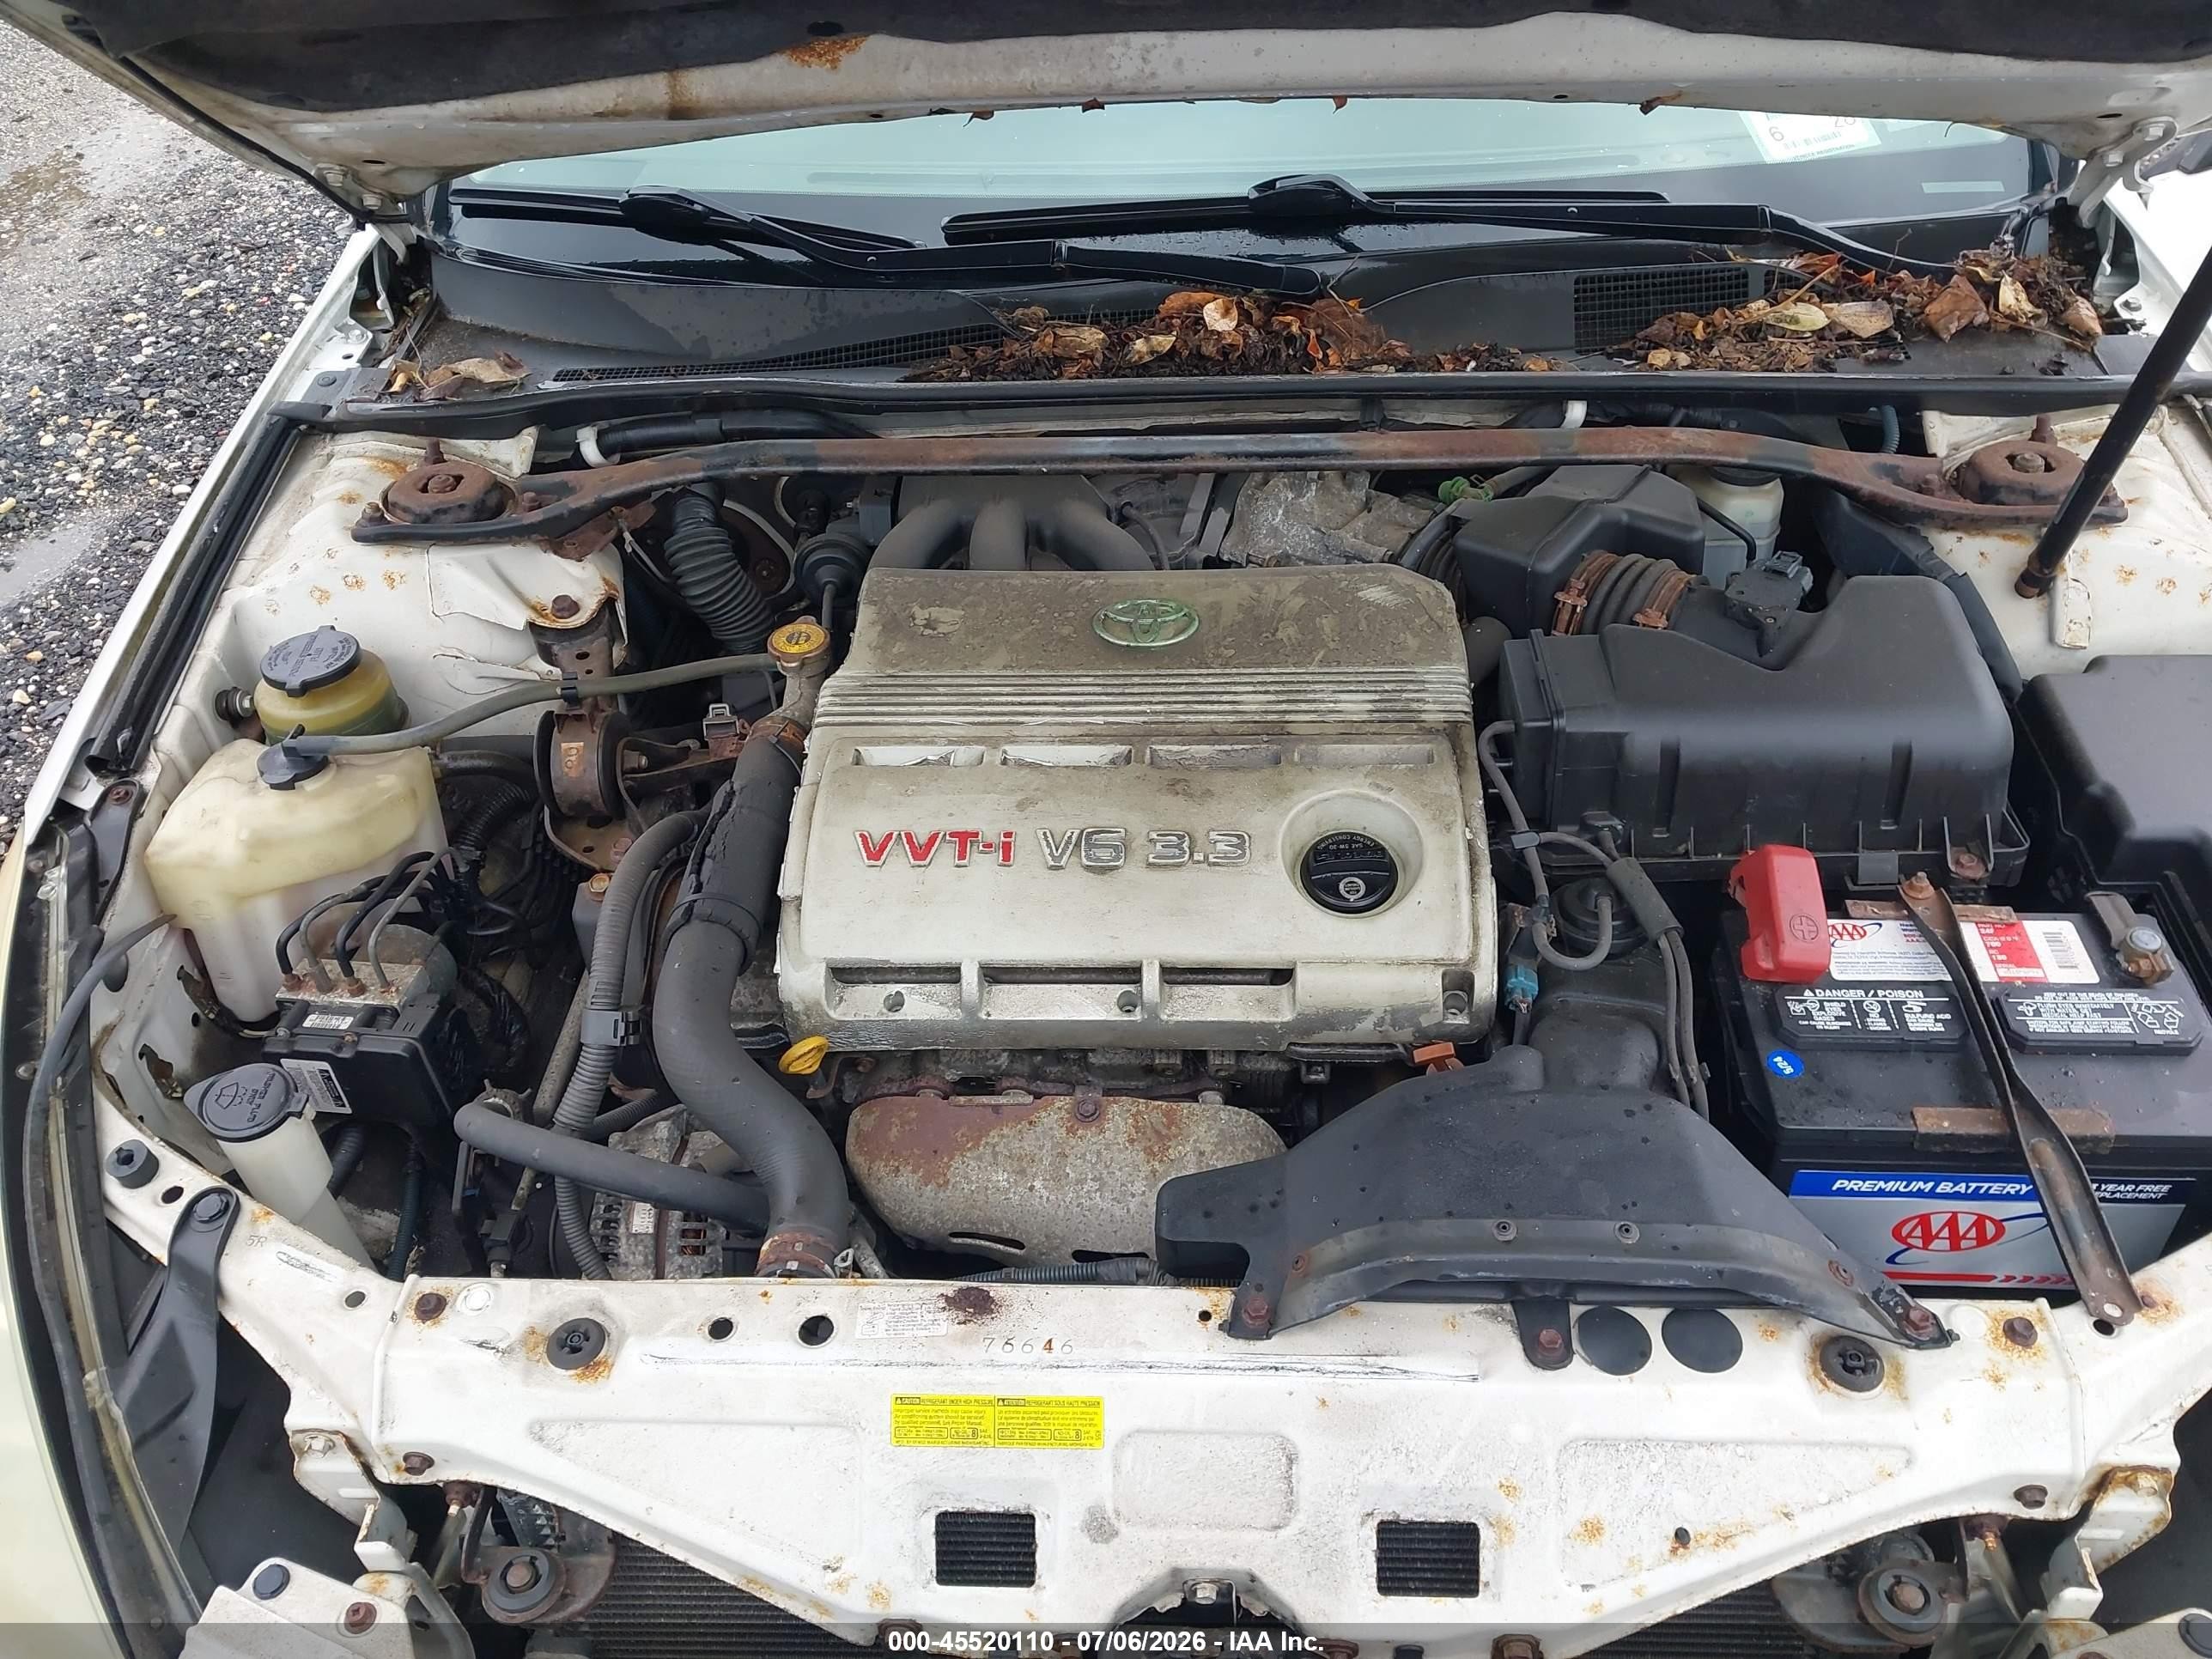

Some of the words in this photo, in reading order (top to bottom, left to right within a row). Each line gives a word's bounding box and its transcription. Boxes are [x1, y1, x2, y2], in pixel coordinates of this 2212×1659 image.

[854, 829, 1018, 867] VVT-i
[1036, 828, 1127, 870] V6
[1147, 830, 1252, 867] 3.3
[1829, 923, 1863, 941] AAA
[1815, 989, 1866, 998] DANGER
[1868, 989, 1875, 998] /
[1877, 989, 1924, 999] POISON
[1772, 1056, 1795, 1075] 5/24
[1832, 1179, 1936, 1193] PREMIUM
[1935, 1182, 2033, 1195] BATTERY
[2100, 1183, 2136, 1192] YEAR
[1899, 1210, 1994, 1251] AAA
[971, 1429, 976, 1438] 8
